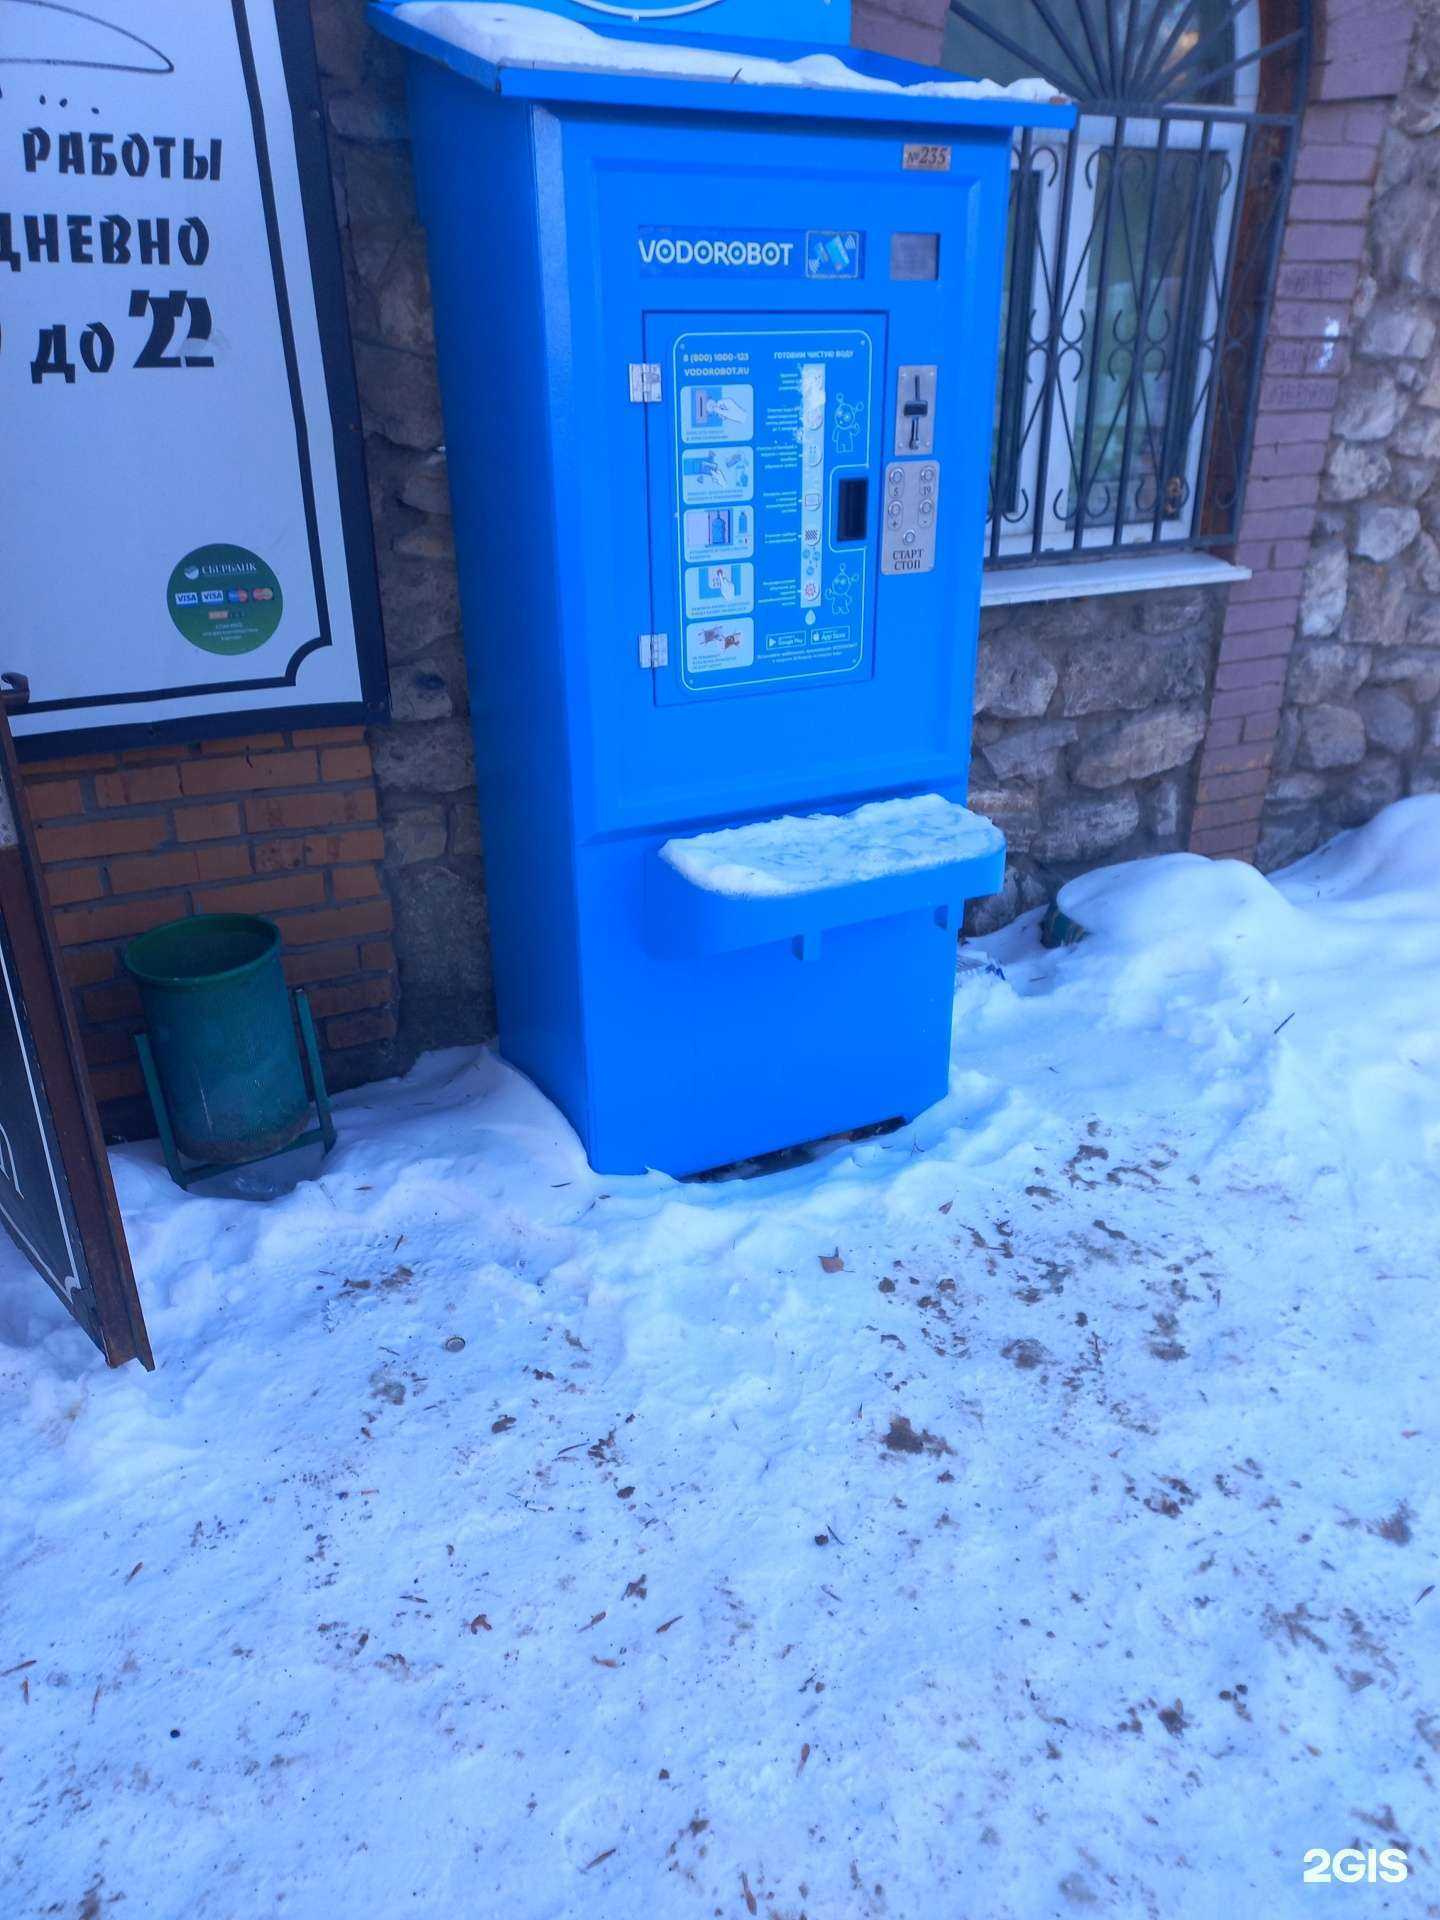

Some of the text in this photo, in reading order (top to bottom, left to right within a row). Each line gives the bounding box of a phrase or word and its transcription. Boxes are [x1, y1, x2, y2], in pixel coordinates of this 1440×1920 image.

[23, 126, 222, 181] РАБОТЫ
[638, 239, 794, 266] VODOROBOT
[892, 548, 924, 561] СТАРТ
[894, 559, 921, 571] СТОП
